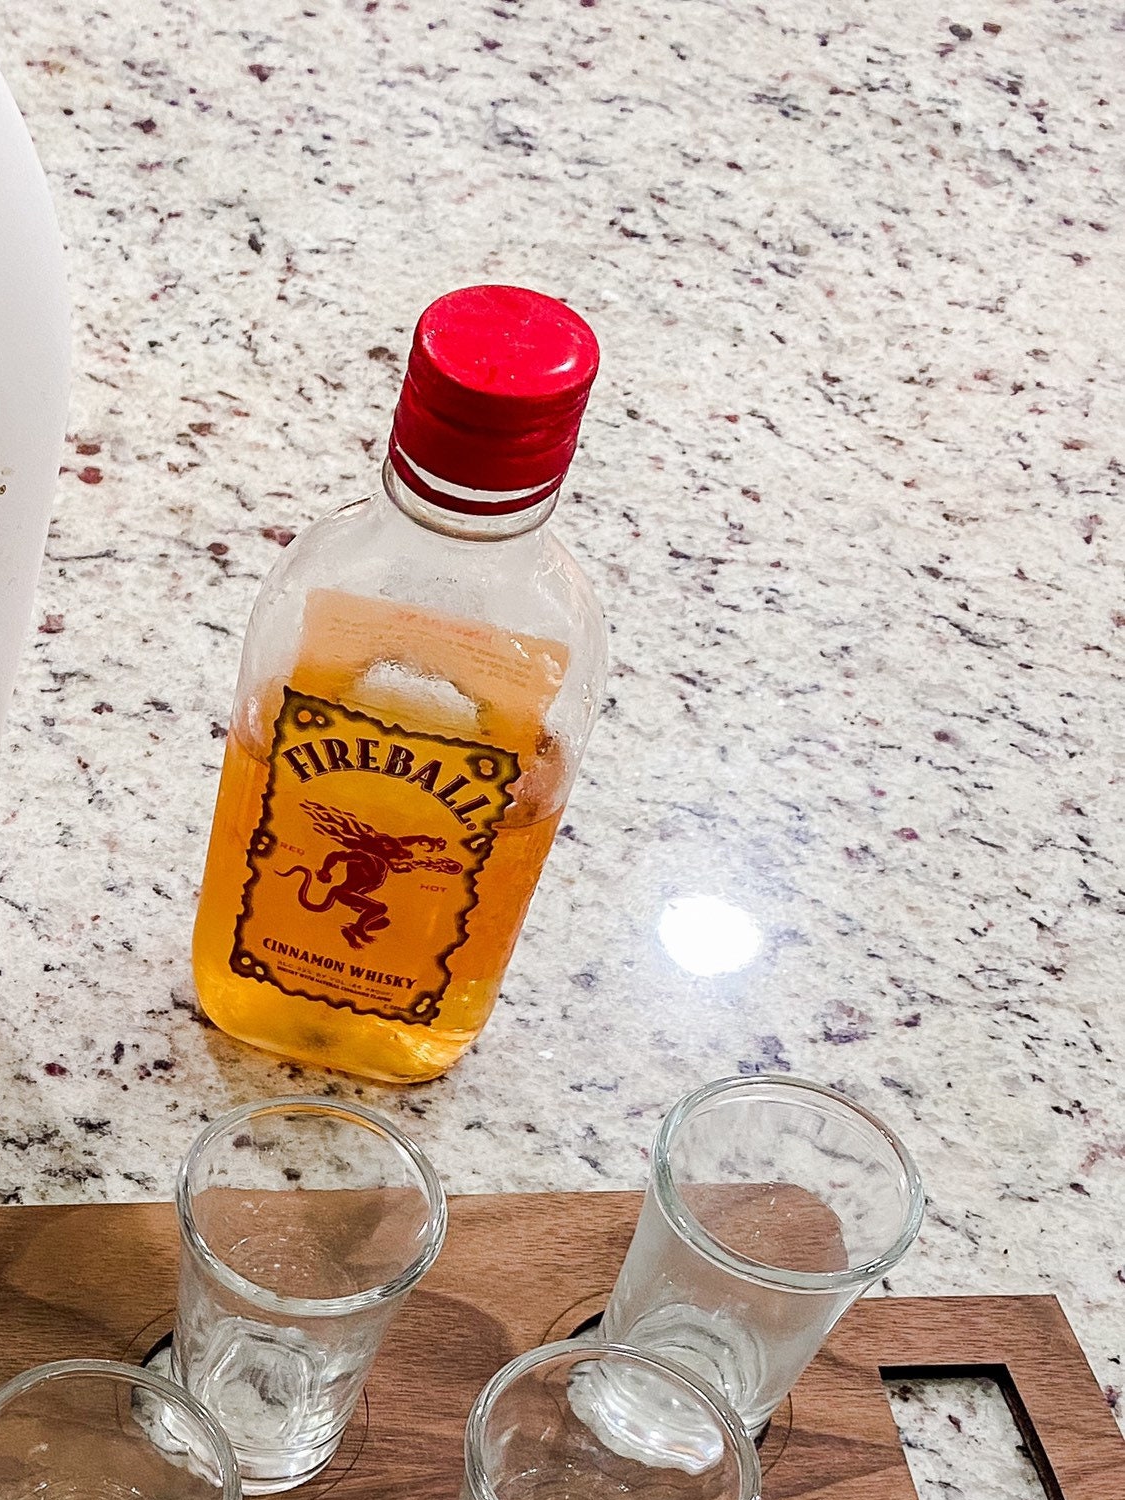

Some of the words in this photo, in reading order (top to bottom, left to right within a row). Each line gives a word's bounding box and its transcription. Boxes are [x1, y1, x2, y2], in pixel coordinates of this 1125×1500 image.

[281, 737, 492, 828] FIREBALL
[280, 841, 305, 857] RED
[419, 883, 448, 893] HOT
[262, 937, 346, 974] CINNAMON
[349, 965, 418, 989] WHISKY
